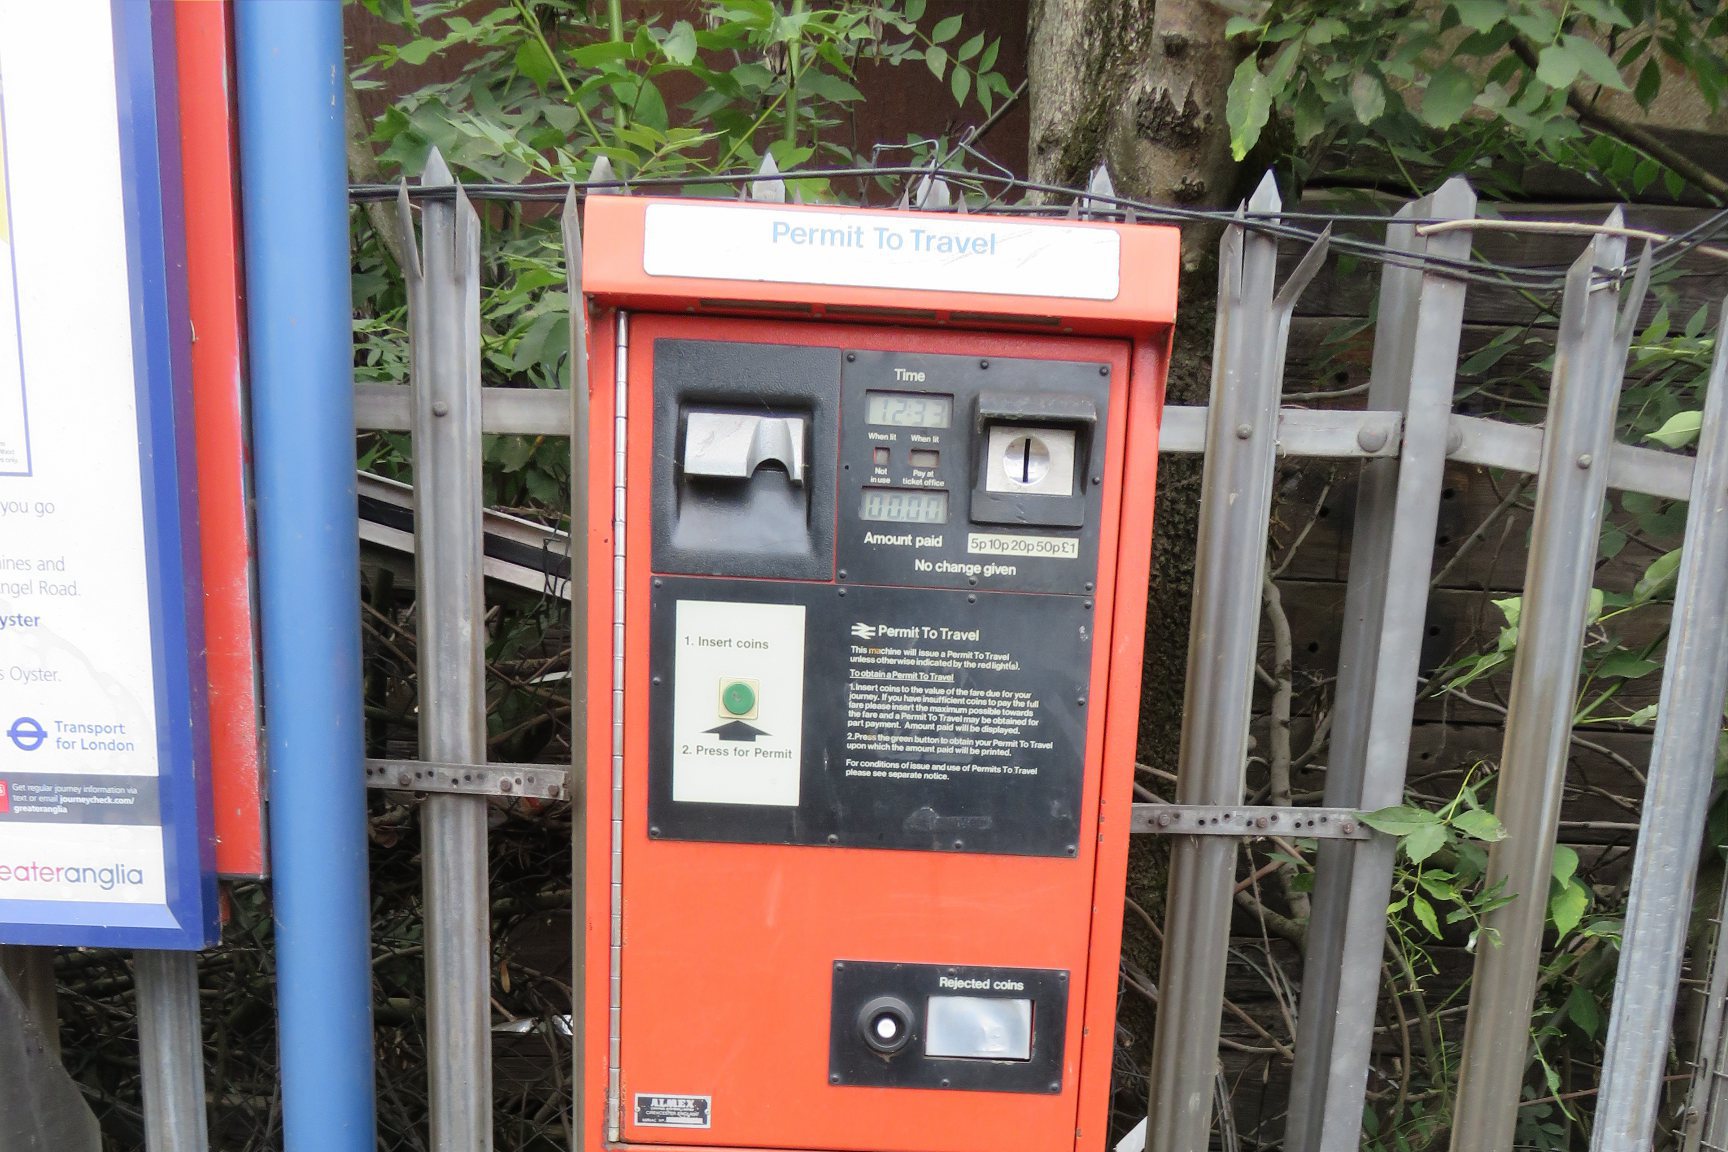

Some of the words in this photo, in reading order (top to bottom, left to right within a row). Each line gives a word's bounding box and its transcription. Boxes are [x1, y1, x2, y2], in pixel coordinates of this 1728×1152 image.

[772, 221, 864, 249] Permit
[874, 228, 903, 251] To
[910, 230, 996, 256] Travel
[894, 368, 926, 382] Time
[868, 432, 888, 441] When
[911, 435, 931, 443] When
[875, 468, 888, 476] Not
[912, 470, 926, 480] Pay
[902, 478, 922, 487] ticket
[924, 479, 945, 488] office
[1, 501, 29, 517] you
[35, 501, 55, 518] go
[864, 532, 913, 546] Amount
[915, 534, 943, 548] paid
[971, 538, 986, 552] 5p
[989, 538, 1009, 552] 10p
[1011, 539, 1035, 553] 20p
[1036, 540, 1060, 554] 50p
[1061, 541, 1076, 554] £1
[0, 554, 32, 571] ines
[37, 556, 65, 572] and
[915, 560, 932, 572] No
[935, 561, 982, 577] change
[983, 563, 1017, 577] given
[0, 579, 33, 598] ngel
[39, 580, 81, 597] Road.
[878, 624, 920, 638] Permit
[922, 627, 938, 639] To
[940, 628, 980, 641] Travel
[685, 636, 694, 646] 1.
[698, 636, 732, 648] Insert
[736, 638, 769, 650] coins
[851, 646, 868, 654] This
[868, 646, 901, 656] machine
[903, 648, 916, 657] will
[918, 649, 939, 658] issue
[947, 650, 973, 659] Permit
[974, 651, 984, 660] To
[985, 652, 1010, 661] Travel
[850, 654, 875, 664] unless
[876, 656, 916, 666] otherwise
[916, 658, 952, 668] indicated
[963, 660, 976, 669] the
[977, 661, 992, 670] red
[992, 661, 1020, 673] light(s).
[10, 665, 62, 685] Oyster.
[850, 669, 860, 677] To
[861, 669, 886, 678] obtain
[892, 670, 918, 680] Permit
[919, 672, 929, 680] To
[930, 672, 954, 681] Travel
[849, 682, 878, 692] 1.Insert
[880, 684, 900, 693] coins
[911, 685, 923, 694] the
[924, 686, 945, 695] value
[956, 687, 968, 696] the
[969, 688, 984, 696] fare
[986, 688, 1000, 697] due
[1002, 689, 1013, 698] for
[1014, 691, 1032, 700] your
[849, 691, 880, 703] journey.
[888, 695, 902, 704] you
[904, 694, 921, 703] have
[922, 695, 965, 705] insufficient
[966, 697, 987, 706] coins
[997, 700, 1012, 708] pay
[1012, 699, 1025, 707] the
[1026, 699, 1039, 708] full
[849, 700, 864, 709] fare
[865, 701, 891, 712] please
[892, 702, 914, 711] insert
[916, 703, 929, 712] the
[930, 704, 967, 714] maximum
[968, 706, 1001, 717] possible
[1002, 707, 1033, 717] towards
[848, 709, 861, 718] the
[862, 710, 878, 719] fare
[879, 711, 894, 720] and
[901, 712, 927, 721] Permit
[939, 713, 962, 723] Travel
[963, 716, 980, 725] may
[981, 715, 991, 724] be
[992, 716, 1026, 725] obtained
[1028, 717, 1039, 726] for
[54, 720, 126, 736] Transport
[848, 718, 864, 729] part
[865, 719, 901, 730] payment.
[904, 721, 935, 730] Amount
[936, 722, 954, 733] paid
[955, 723, 969, 732] will
[970, 724, 980, 733] be
[981, 724, 1020, 736] displayed.
[56, 737, 76, 750] for
[81, 738, 135, 752] London
[847, 731, 876, 741] 2.Press
[878, 733, 890, 742] the
[891, 735, 913, 744] green
[914, 734, 940, 744] button
[949, 736, 974, 745] obtain
[975, 739, 992, 748] your
[993, 738, 1018, 747] Permit
[1019, 739, 1029, 748] To
[1030, 740, 1053, 749] Travel
[682, 745, 692, 755] 2.
[696, 745, 729, 757] Press
[733, 746, 750, 757] for
[754, 747, 793, 760] Permit
[847, 742, 866, 751] upon
[868, 742, 890, 751] which
[891, 743, 904, 751] the
[905, 743, 935, 753] amount
[937, 745, 954, 755] paid
[955, 746, 968, 754] will
[970, 746, 980, 755] be
[981, 747, 1012, 758] printed.
[846, 758, 859, 767] For
[860, 758, 899, 768] conditions
[910, 761, 930, 770] issue
[932, 762, 946, 771] and
[962, 763, 971, 772] of
[972, 764, 1001, 773] Permits
[1002, 765, 1013, 774] To
[1014, 765, 1038, 775] Travel
[846, 767, 871, 778] please
[888, 769, 922, 780] separate
[924, 771, 949, 780] notice.
[12, 783, 26, 792] Get
[28, 784, 53, 793] regular
[54, 784, 81, 794] journey
[83, 785, 126, 794] information
[126, 786, 138, 794] via
[13, 794, 27, 802] text
[38, 794, 58, 803] email
[59, 795, 135, 806] journeycheck.com/
[13, 805, 68, 815] greateranglia
[939, 976, 990, 990] Rejected
[993, 978, 1024, 991] coins
[650, 1098, 695, 1108] ALMEX
